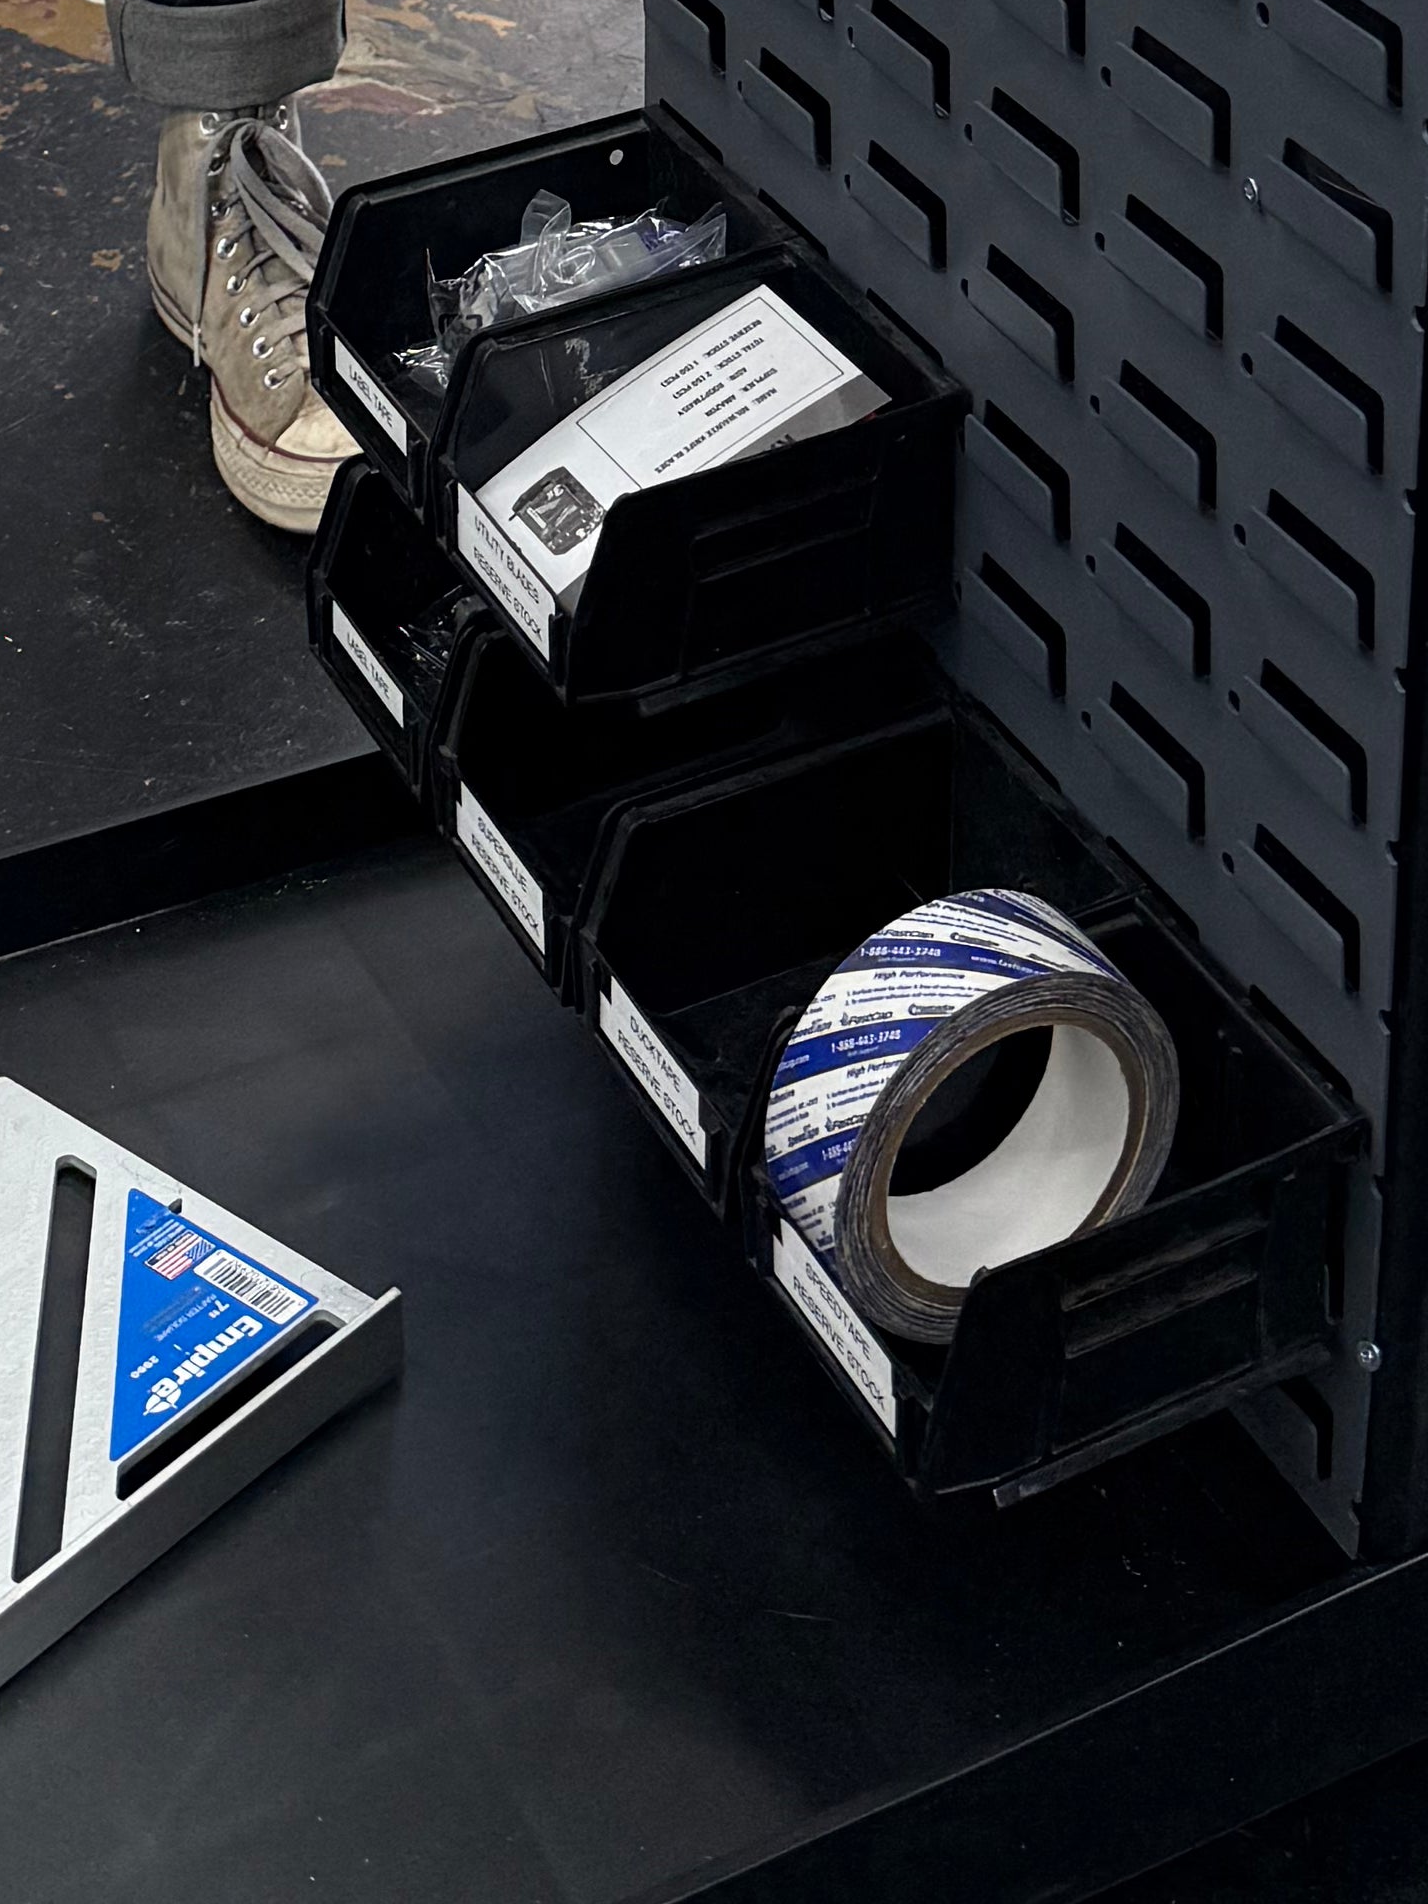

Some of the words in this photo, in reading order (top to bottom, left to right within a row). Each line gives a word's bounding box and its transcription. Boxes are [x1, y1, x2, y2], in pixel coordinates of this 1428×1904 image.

[349, 364, 372, 402] LABEL
[373, 393, 393, 428] TAPE
[473, 546, 512, 604] RESERVE
[513, 597, 543, 642] STOCK
[474, 515, 504, 561] UTILITY
[506, 555, 540, 604] BLADES
[347, 632, 370, 672] LABEL
[370, 662, 390, 700] TAPE
[471, 833, 510, 894] RESERVE
[511, 889, 540, 938] STOCK
[478, 816, 528, 894] SUPERGLUE
[617, 1029, 662, 1098] RESERVE
[663, 1092, 697, 1146] STOCK
[630, 1015, 681, 1093] DUCKTAPE
[207, 1299, 231, 1320] 7"
[793, 1275, 845, 1356] RESERVE
[846, 1349, 886, 1413] STOCK
[805, 1261, 871, 1361] SPEEDTAPE
[150, 1314, 264, 1399] Empire
